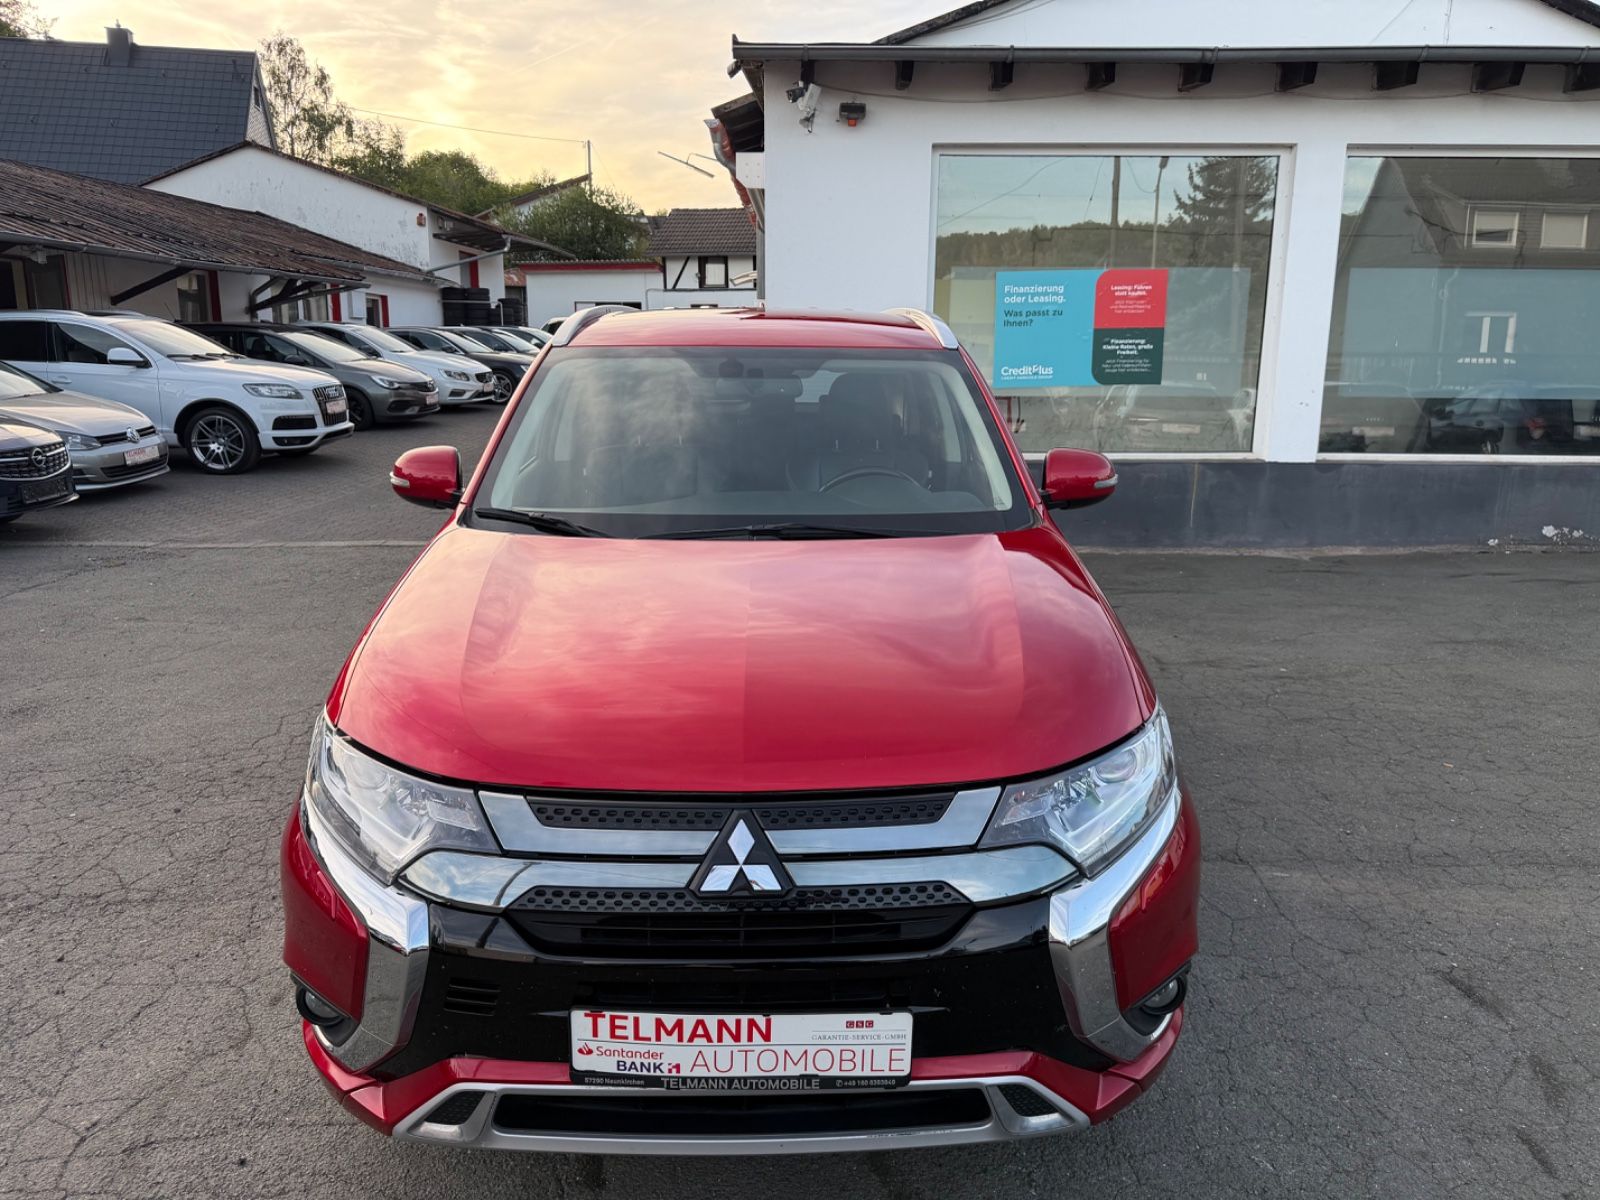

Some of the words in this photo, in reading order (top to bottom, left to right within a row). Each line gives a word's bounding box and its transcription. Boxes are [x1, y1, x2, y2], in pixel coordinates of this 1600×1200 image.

[1004, 284, 1065, 294] Finanzierung
[1004, 295, 1026, 303] oder
[1028, 294, 1066, 304] Leasing.
[1004, 309, 1023, 317] Was
[1025, 309, 1050, 319] passt
[1052, 309, 1063, 317] zu
[1003, 319, 1034, 328] Ihnen?
[1001, 364, 1053, 376] CreditPlus
[584, 1012, 772, 1044] TELMANN
[596, 1045, 664, 1061] Santander
[690, 1048, 906, 1073] AUTOMOBILE
[616, 1060, 664, 1074] BANK
[661, 1077, 729, 1090] TELMANN
[731, 1079, 820, 1090] AUTOMOBILE
